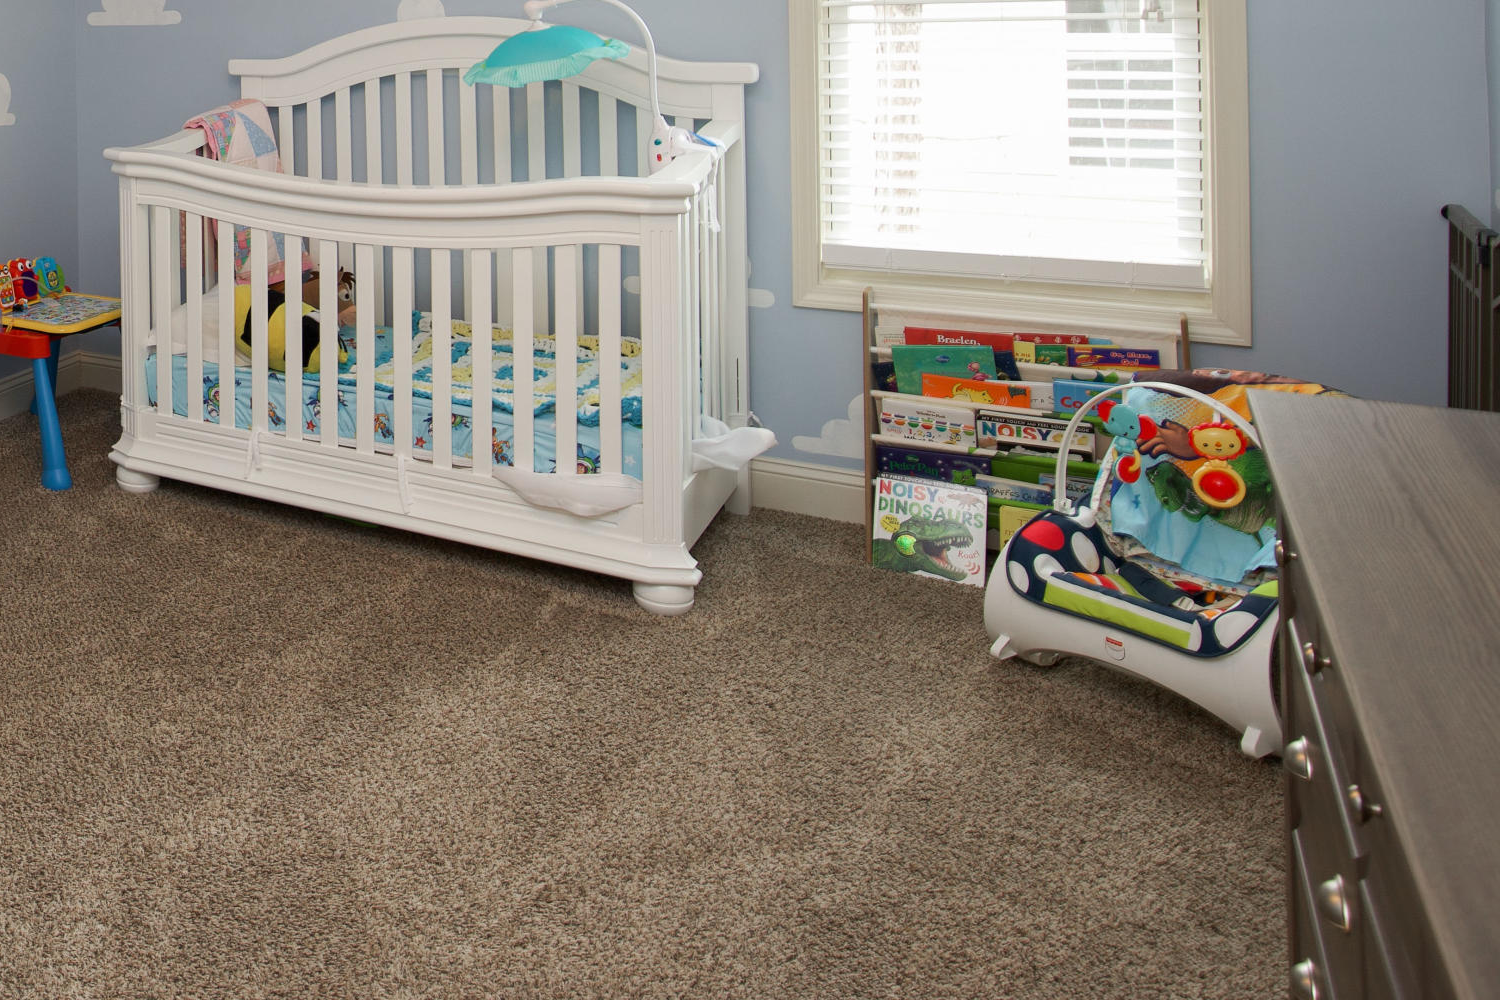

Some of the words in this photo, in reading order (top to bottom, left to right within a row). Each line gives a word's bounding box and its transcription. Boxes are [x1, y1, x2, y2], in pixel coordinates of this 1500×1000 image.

[982, 421, 1052, 441] NOISY
[880, 479, 940, 503] NOISY
[879, 496, 984, 529] DINOSAURS
